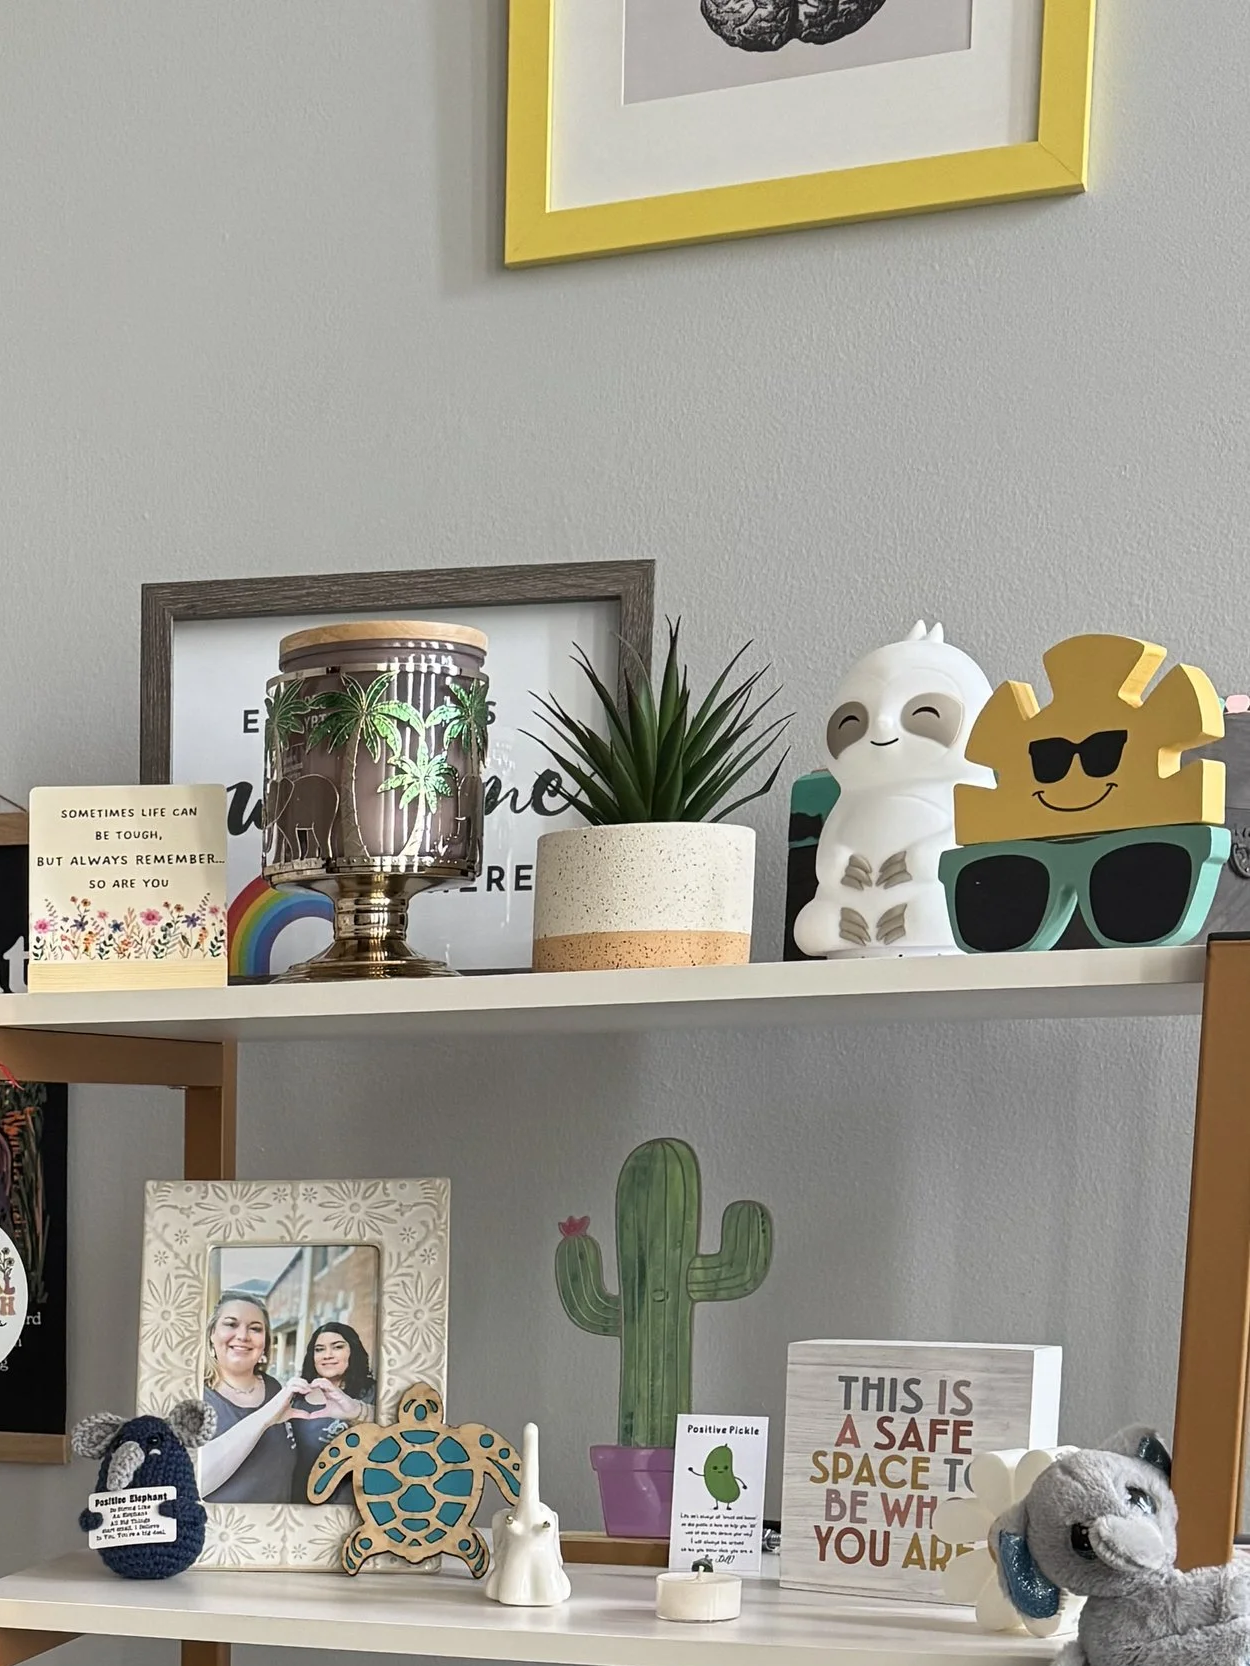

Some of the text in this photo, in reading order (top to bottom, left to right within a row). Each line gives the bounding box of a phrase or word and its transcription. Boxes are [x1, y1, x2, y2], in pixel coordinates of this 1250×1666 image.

[61, 807, 197, 819] SOMETIMES LIFE CAN
[95, 831, 163, 841] BE TOUGH,
[37, 854, 225, 867] BUT ALWAYS REMEMBER...
[89, 878, 169, 889] SO ARE YOU
[838, 1375, 973, 1416] THIS IS
[687, 1424, 760, 1435] Positive Pickle
[834, 1414, 973, 1455] A SAFE
[809, 1450, 930, 1490] SPACE
[95, 1492, 167, 1507] Positive Elephant
[825, 1488, 940, 1529] BE WH
[814, 1525, 890, 1567] YOU
